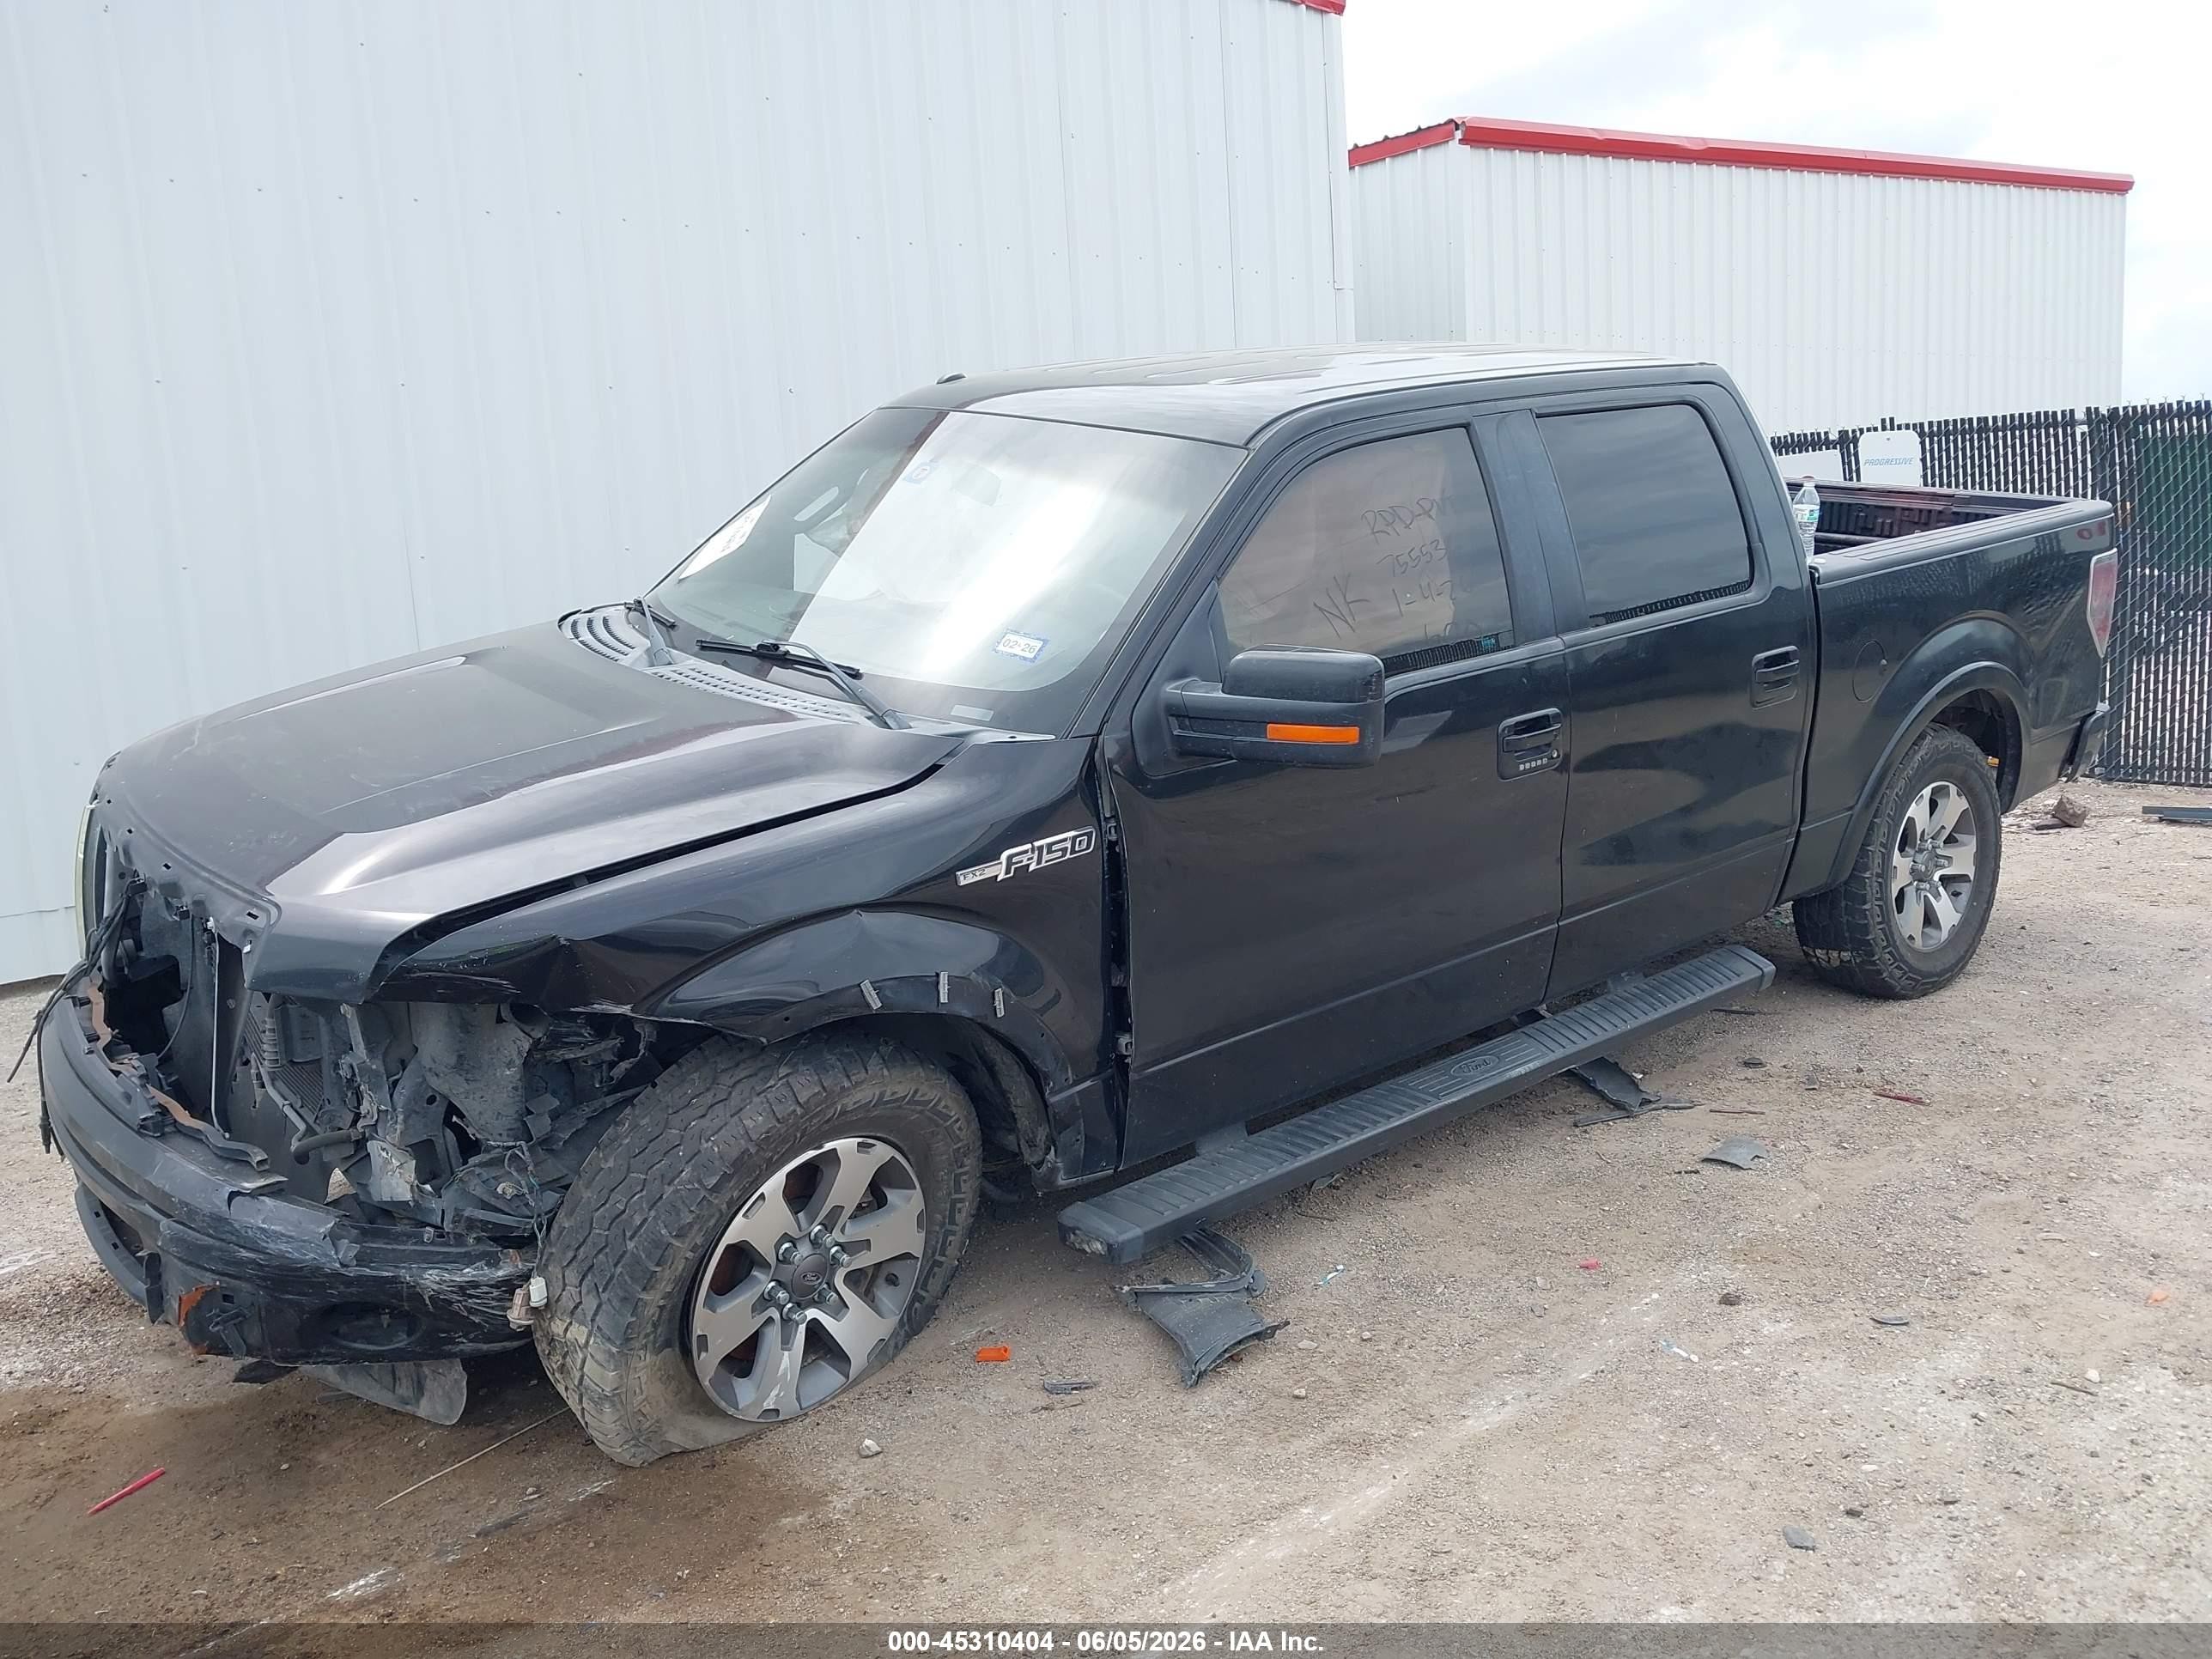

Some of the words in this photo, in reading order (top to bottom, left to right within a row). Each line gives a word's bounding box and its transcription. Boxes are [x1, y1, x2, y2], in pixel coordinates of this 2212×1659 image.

[1863, 457, 1915, 467] PROGRESSIVE
[1313, 571, 1373, 641] NK
[963, 868, 987, 882] FX2
[996, 826, 1097, 883] F-150
